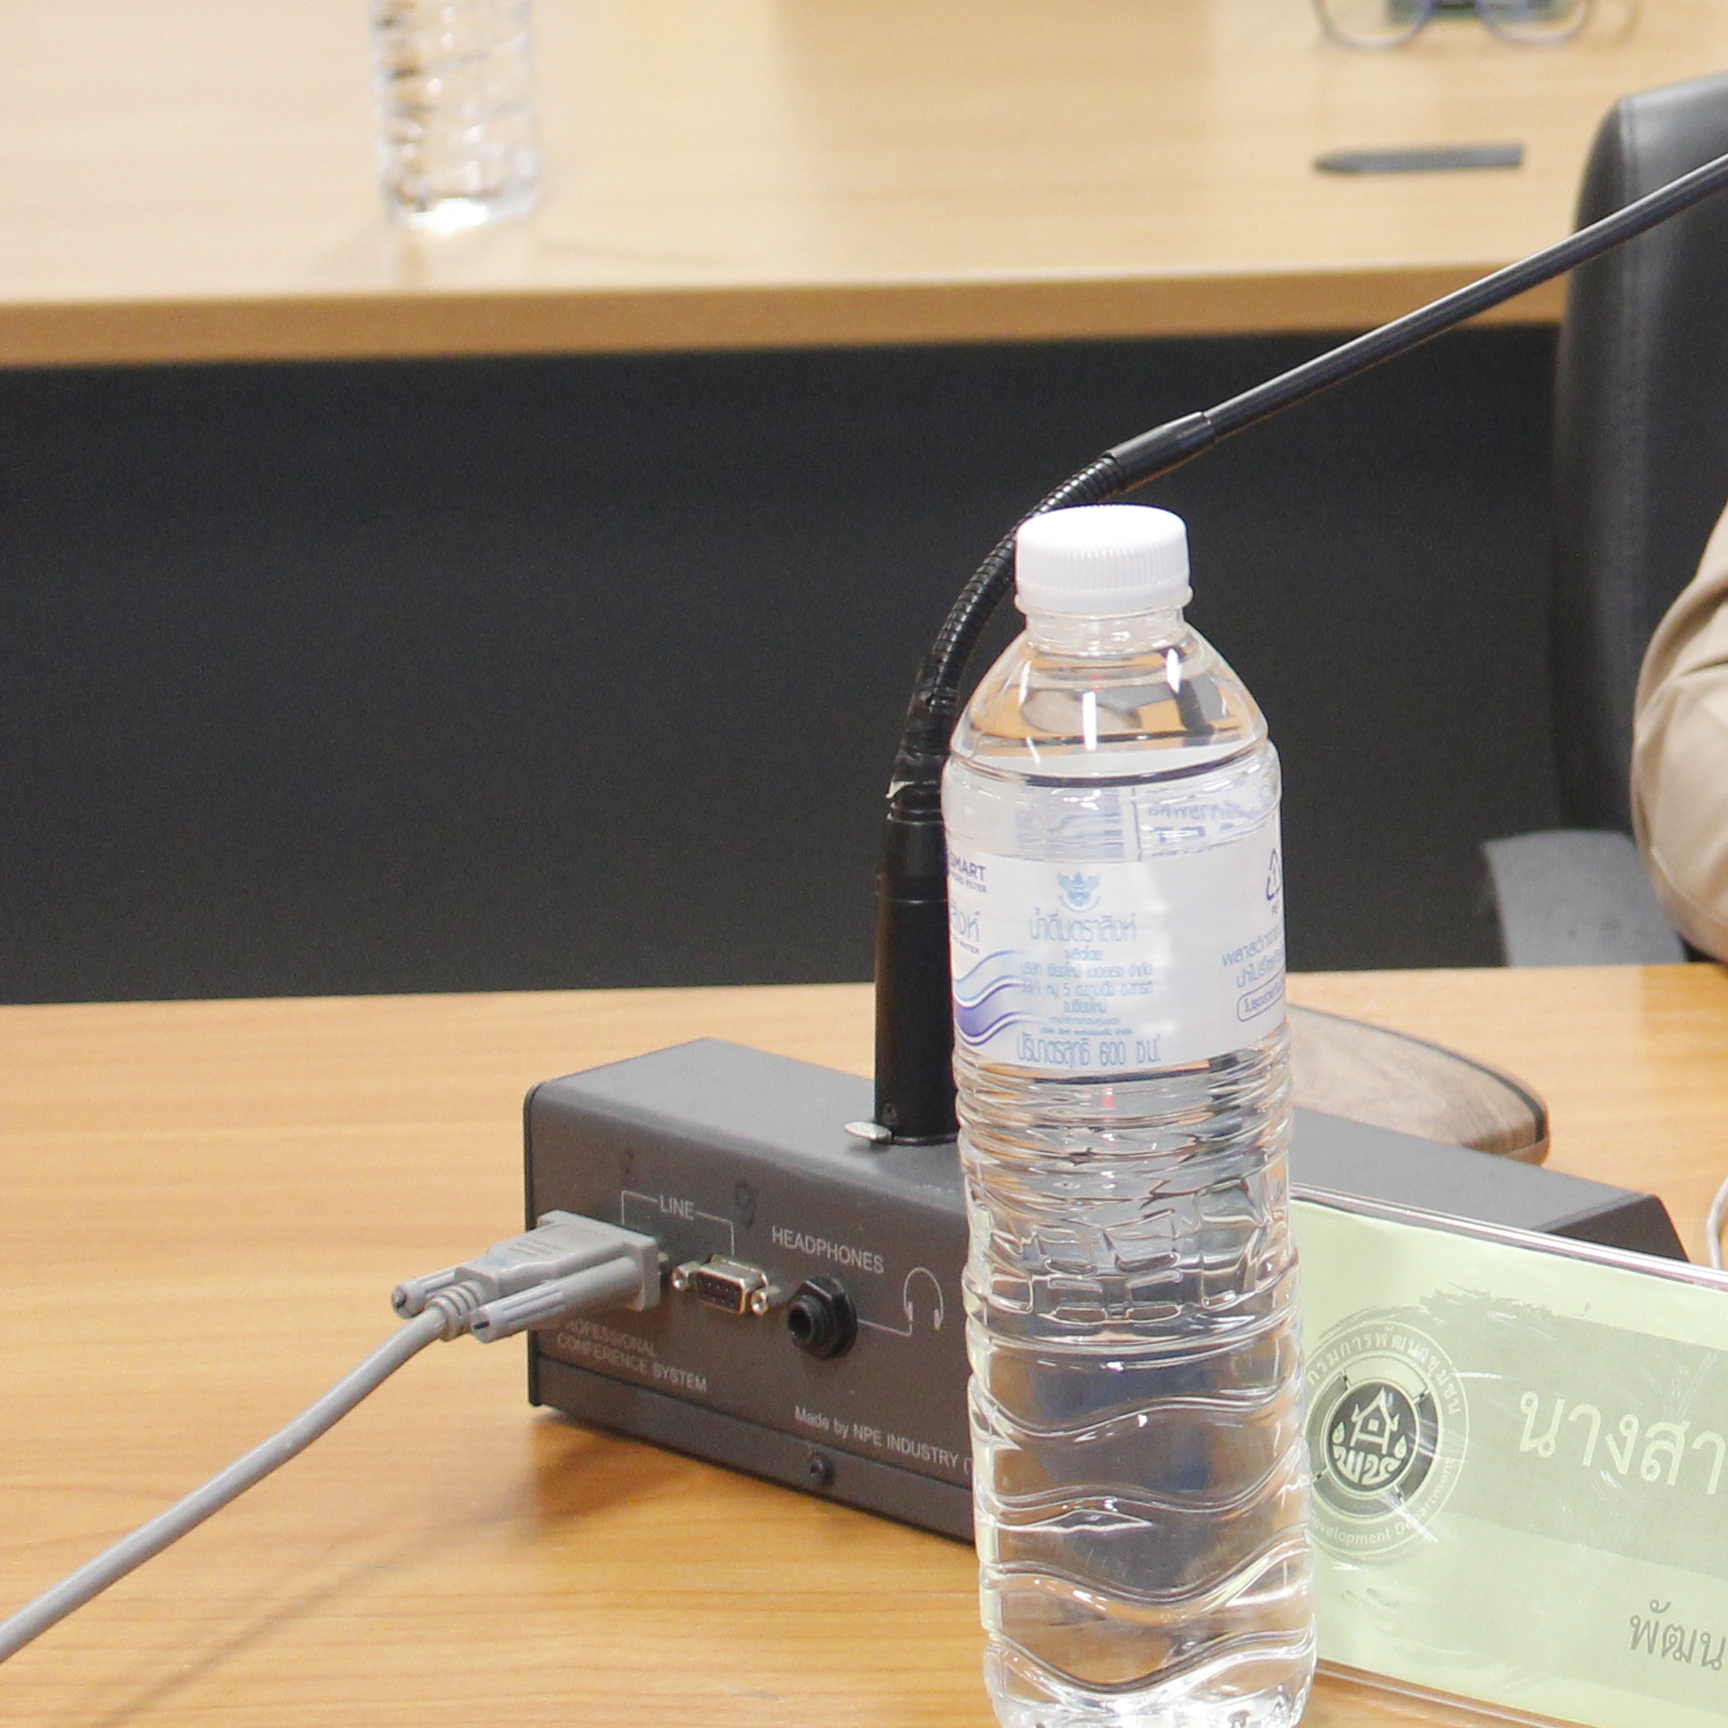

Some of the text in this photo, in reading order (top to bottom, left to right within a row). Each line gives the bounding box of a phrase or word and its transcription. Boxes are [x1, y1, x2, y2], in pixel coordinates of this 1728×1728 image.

[1100, 1040, 1126, 1066] 600
[659, 1194, 696, 1221] LINE
[772, 1225, 884, 1274] HEADPHONES
[651, 1360, 708, 1393] SYSTEM
[795, 1405, 830, 1431] Made
[833, 1418, 850, 1440] by
[852, 1424, 882, 1447] NPE
[886, 1433, 959, 1470] INDUSTRY
[1311, 1509, 1392, 1546] evelopment
